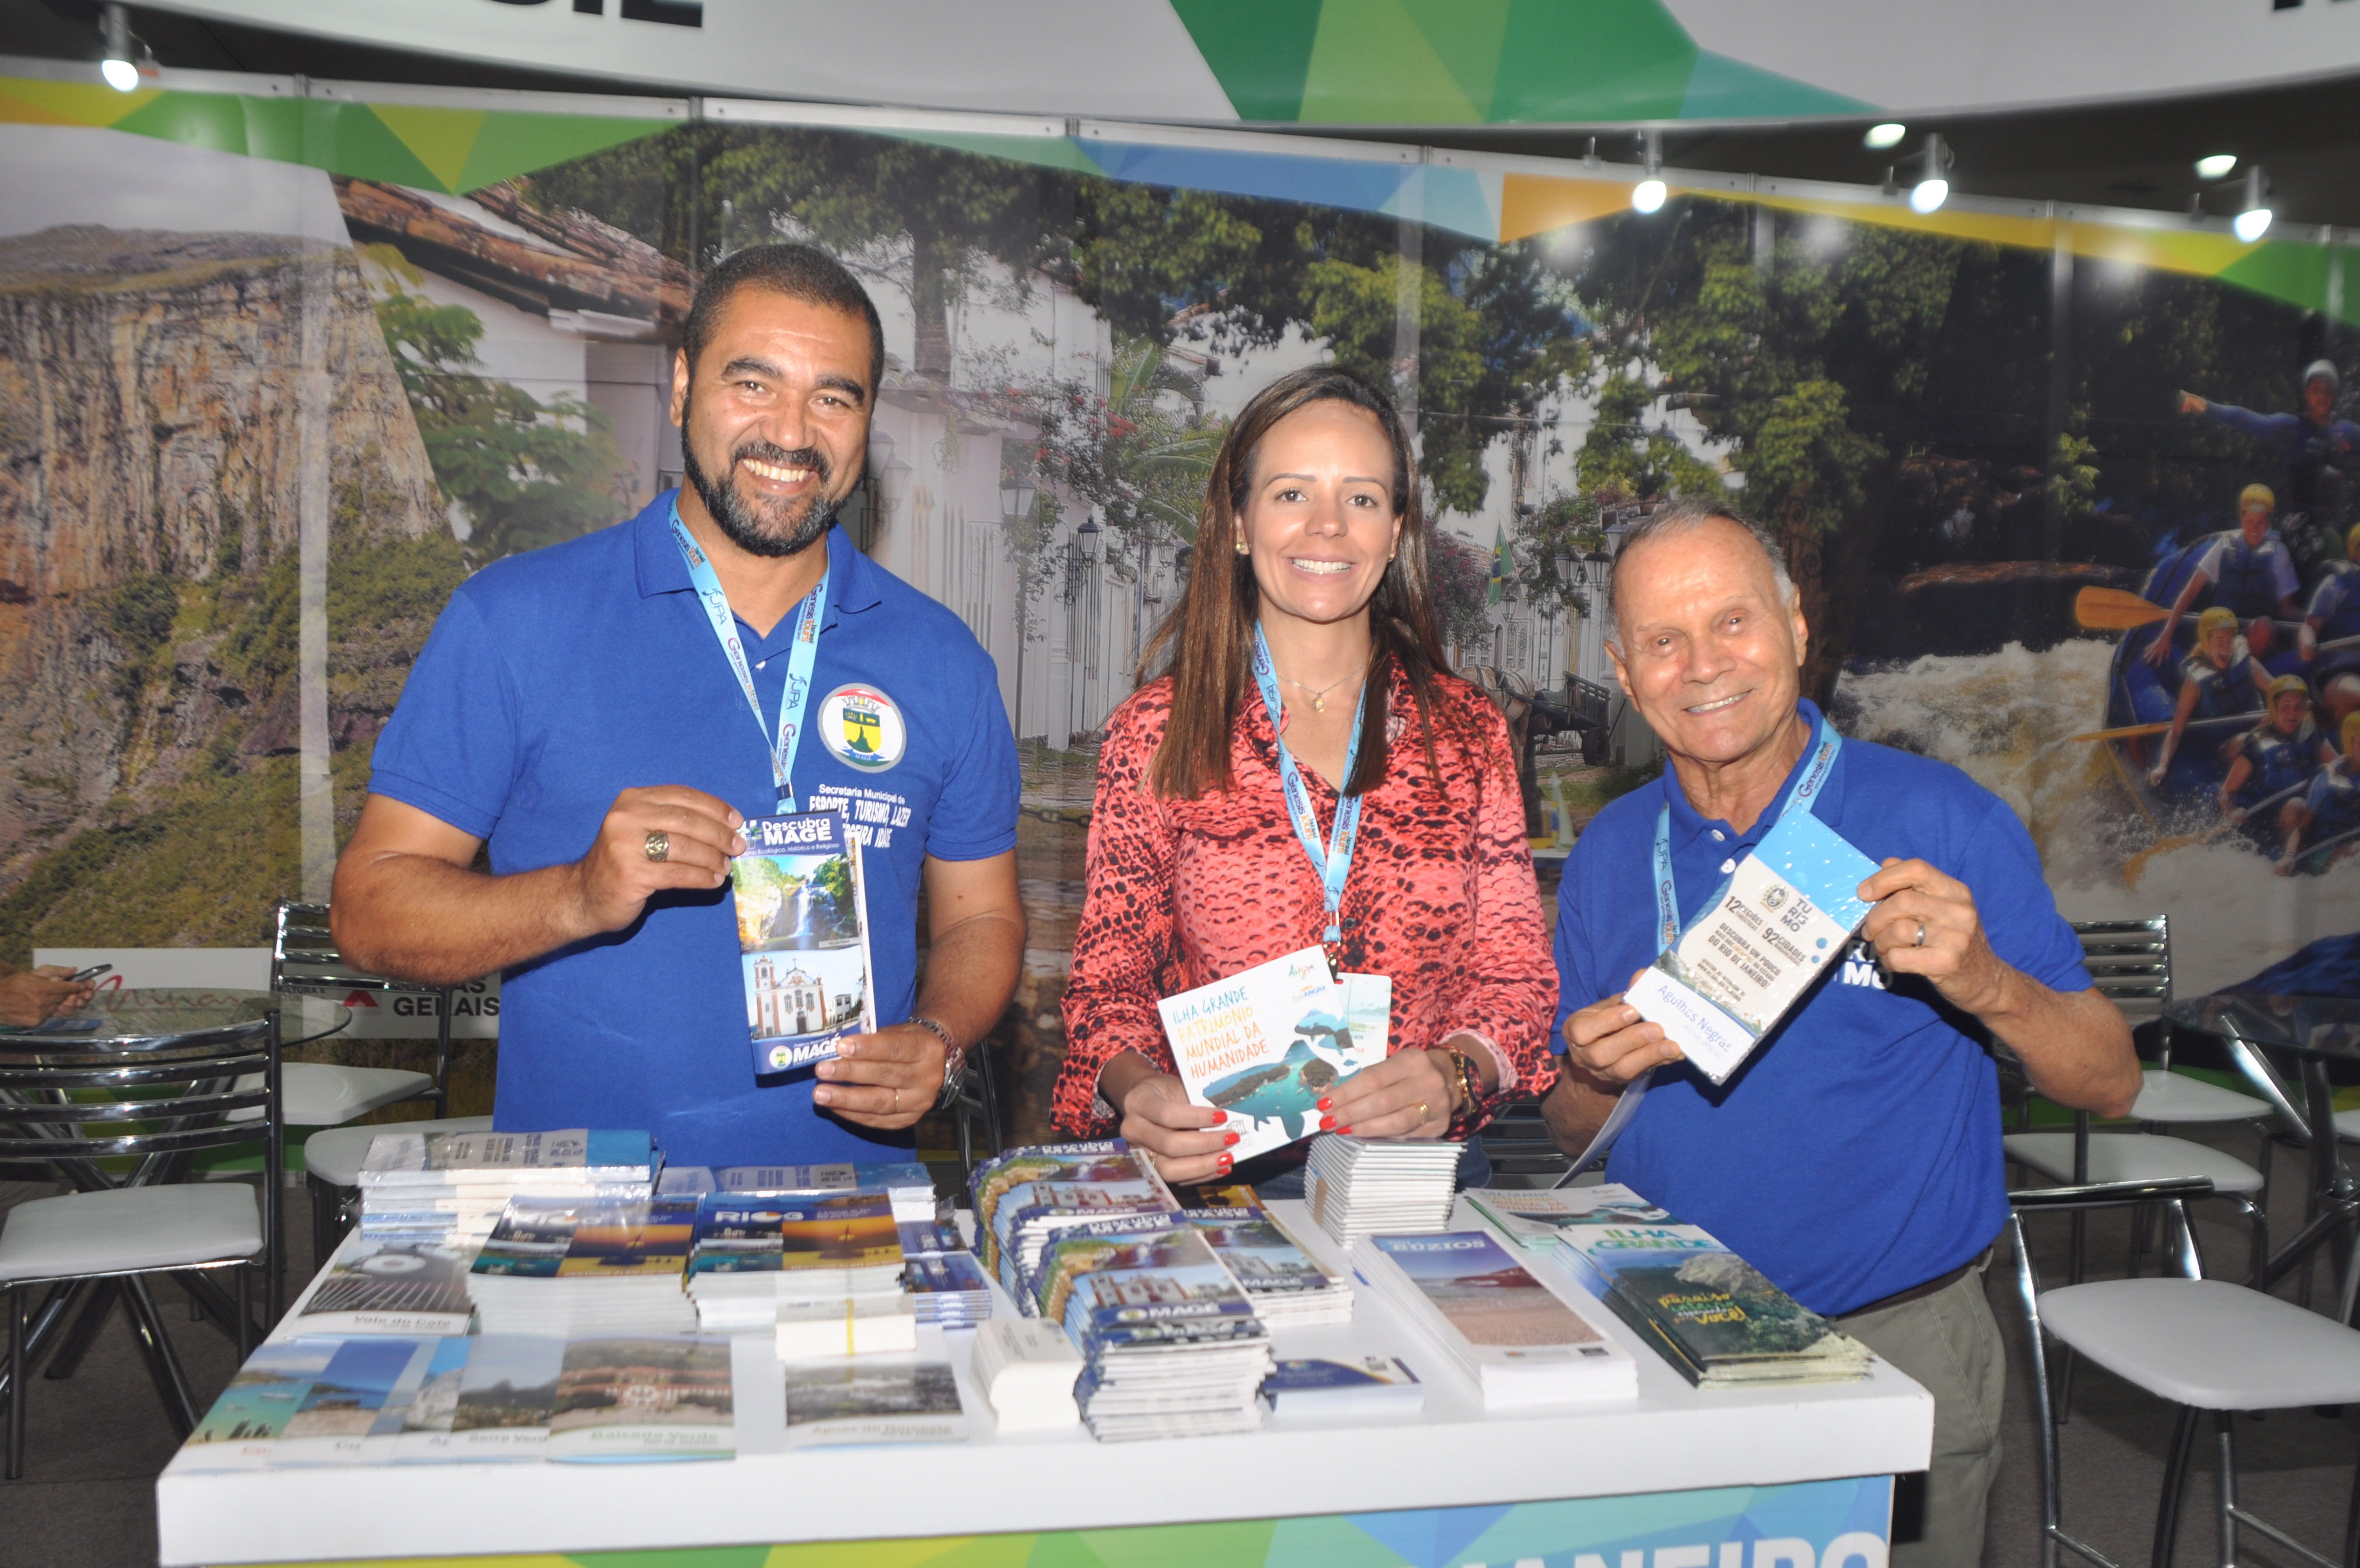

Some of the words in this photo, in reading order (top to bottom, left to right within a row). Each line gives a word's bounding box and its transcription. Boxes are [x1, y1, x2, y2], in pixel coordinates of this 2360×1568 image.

[819, 783, 862, 797] Secretaria
[864, 788, 897, 803] Municipal
[898, 795, 905, 804] de
[1287, 771, 1306, 816] Genesis
[762, 817, 831, 832] Descubra
[764, 827, 832, 846] MAGE
[1308, 818, 1319, 838] Israel
[1344, 837, 1352, 855] Israel
[1723, 894, 1742, 914] 12
[1795, 898, 1814, 914] TU
[1781, 914, 1801, 933] MO
[1718, 922, 1751, 950] DESCUBRA
[1749, 948, 1761, 959] UM
[1758, 955, 1782, 976] POUCO
[1761, 926, 1780, 945] 92
[1776, 935, 1807, 962] CIDADES
[1707, 934, 1720, 947] DO
[1717, 943, 1733, 958] RIO
[1738, 961, 1771, 990] JANEIRO!
[1843, 961, 1893, 990] MO
[393, 996, 500, 1017] GEAIS
[1172, 1004, 1200, 1024] ILHA
[1203, 987, 1249, 1014] GRANDE
[1178, 1006, 1254, 1044] PATRIMÔNIO
[1657, 984, 1698, 1023] Agulhas
[1696, 1018, 1734, 1053] Negras
[793, 1032, 841, 1062] MAGÉ
[1186, 1031, 1243, 1061] MUNDIAL
[1247, 1021, 1262, 1040] DA
[1191, 1039, 1270, 1079] HUMANIDADE
[1591, 1239, 1720, 1251] GRANDE
[1604, 1229, 1683, 1239] ILHA
